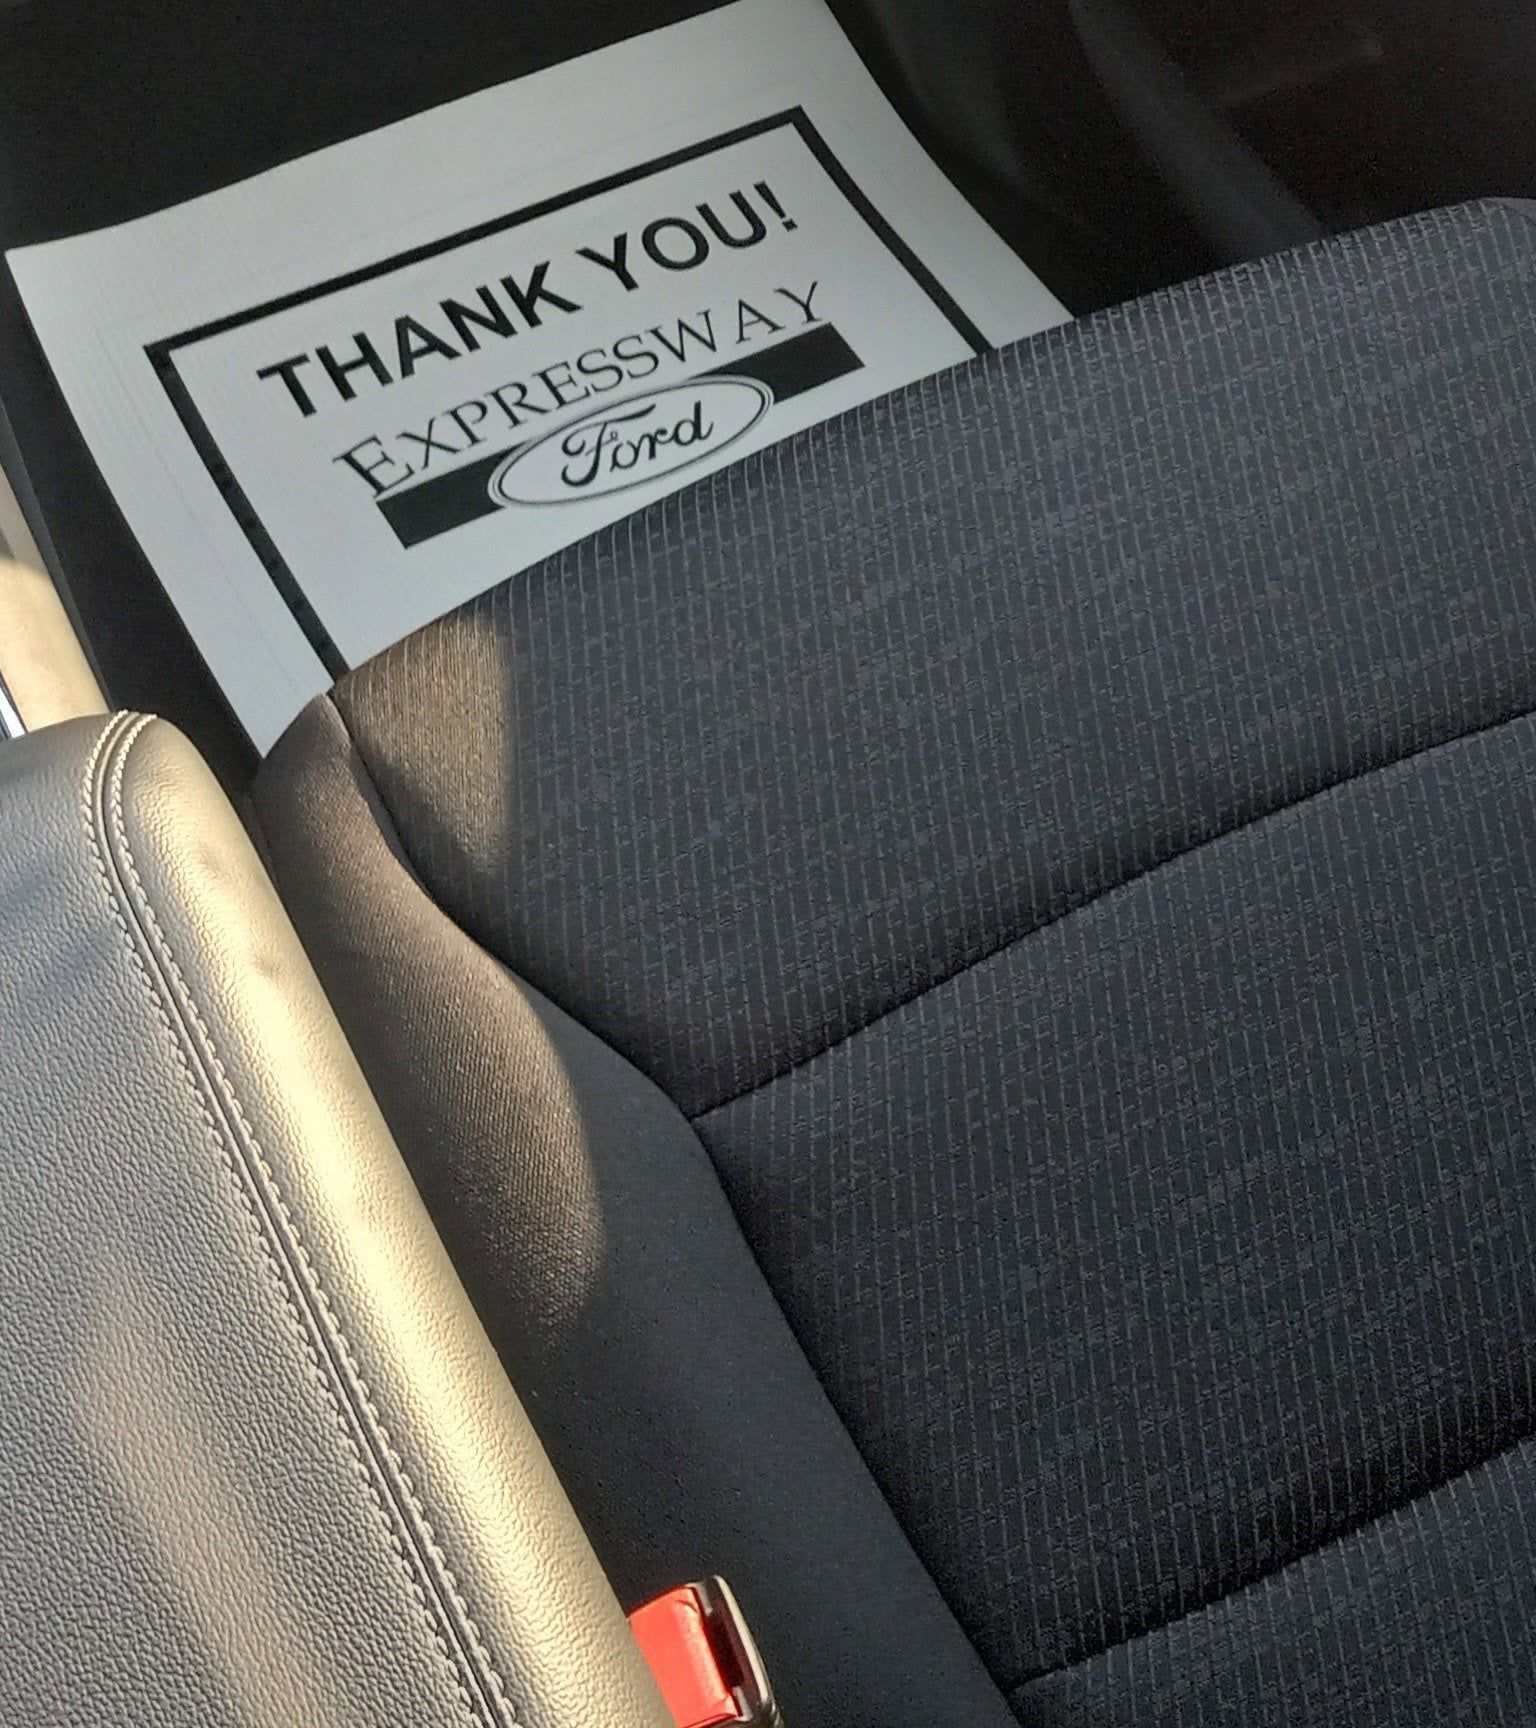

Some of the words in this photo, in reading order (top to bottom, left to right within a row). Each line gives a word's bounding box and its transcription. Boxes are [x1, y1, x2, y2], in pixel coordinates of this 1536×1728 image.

[258, 260, 584, 418] THANK
[576, 179, 801, 294] YOU!
[332, 280, 828, 500] EXPRESSWAY
[560, 400, 714, 488] Ford
